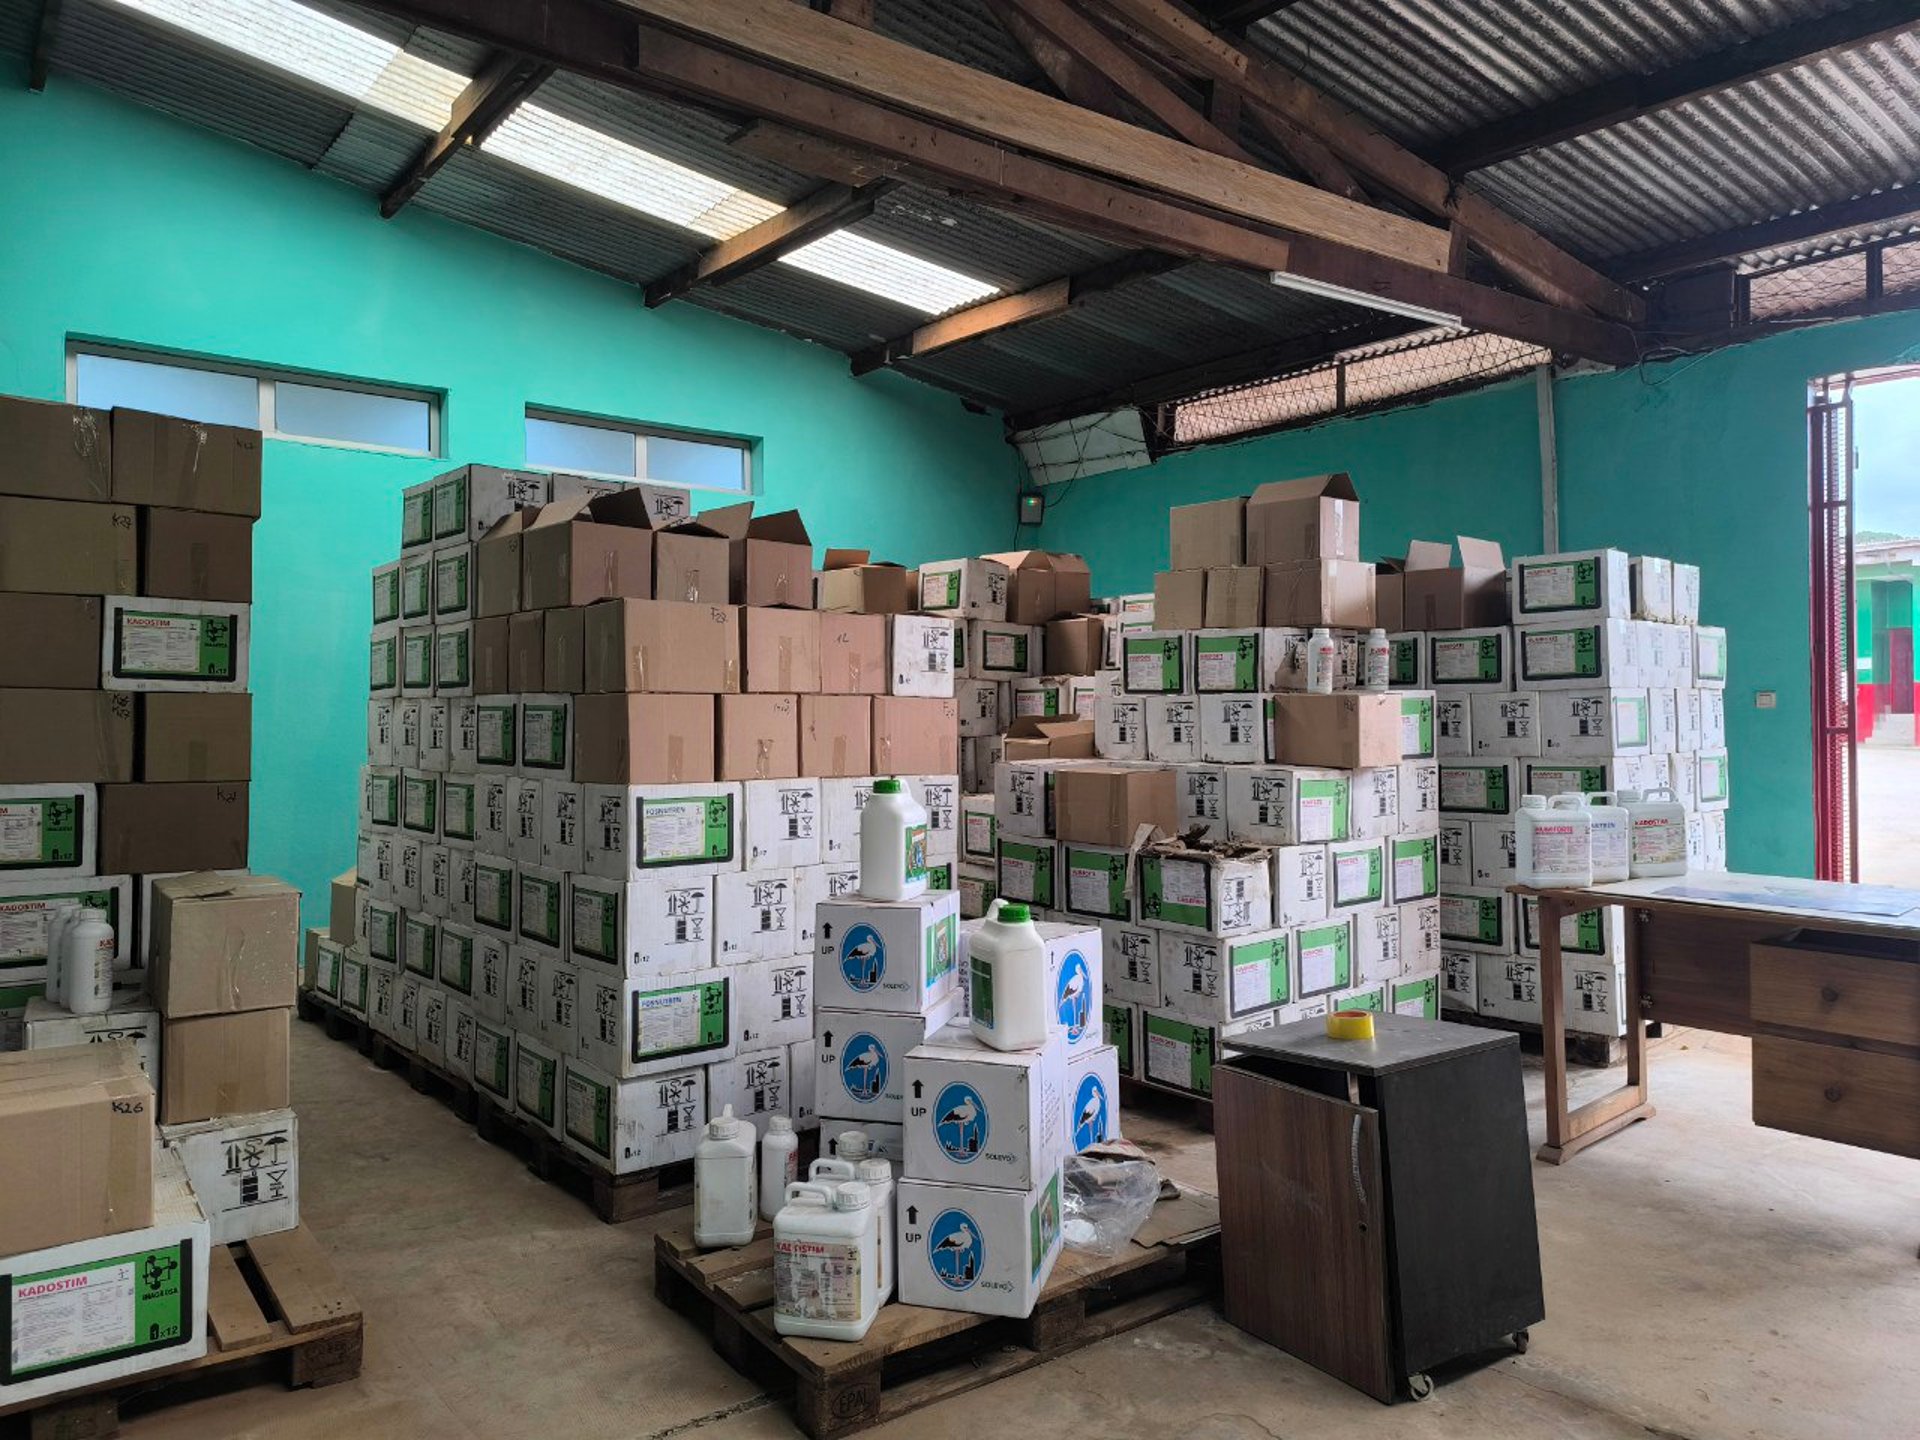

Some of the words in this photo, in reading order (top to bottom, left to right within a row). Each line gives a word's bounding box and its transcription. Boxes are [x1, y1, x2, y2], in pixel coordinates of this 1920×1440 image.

[821, 946, 834, 955] UP
[821, 1054, 836, 1064] UP
[112, 1101, 144, 1113] K26
[911, 1107, 927, 1117] UP
[905, 1232, 922, 1243] UP
[17, 1276, 89, 1298] KADOSTIM
